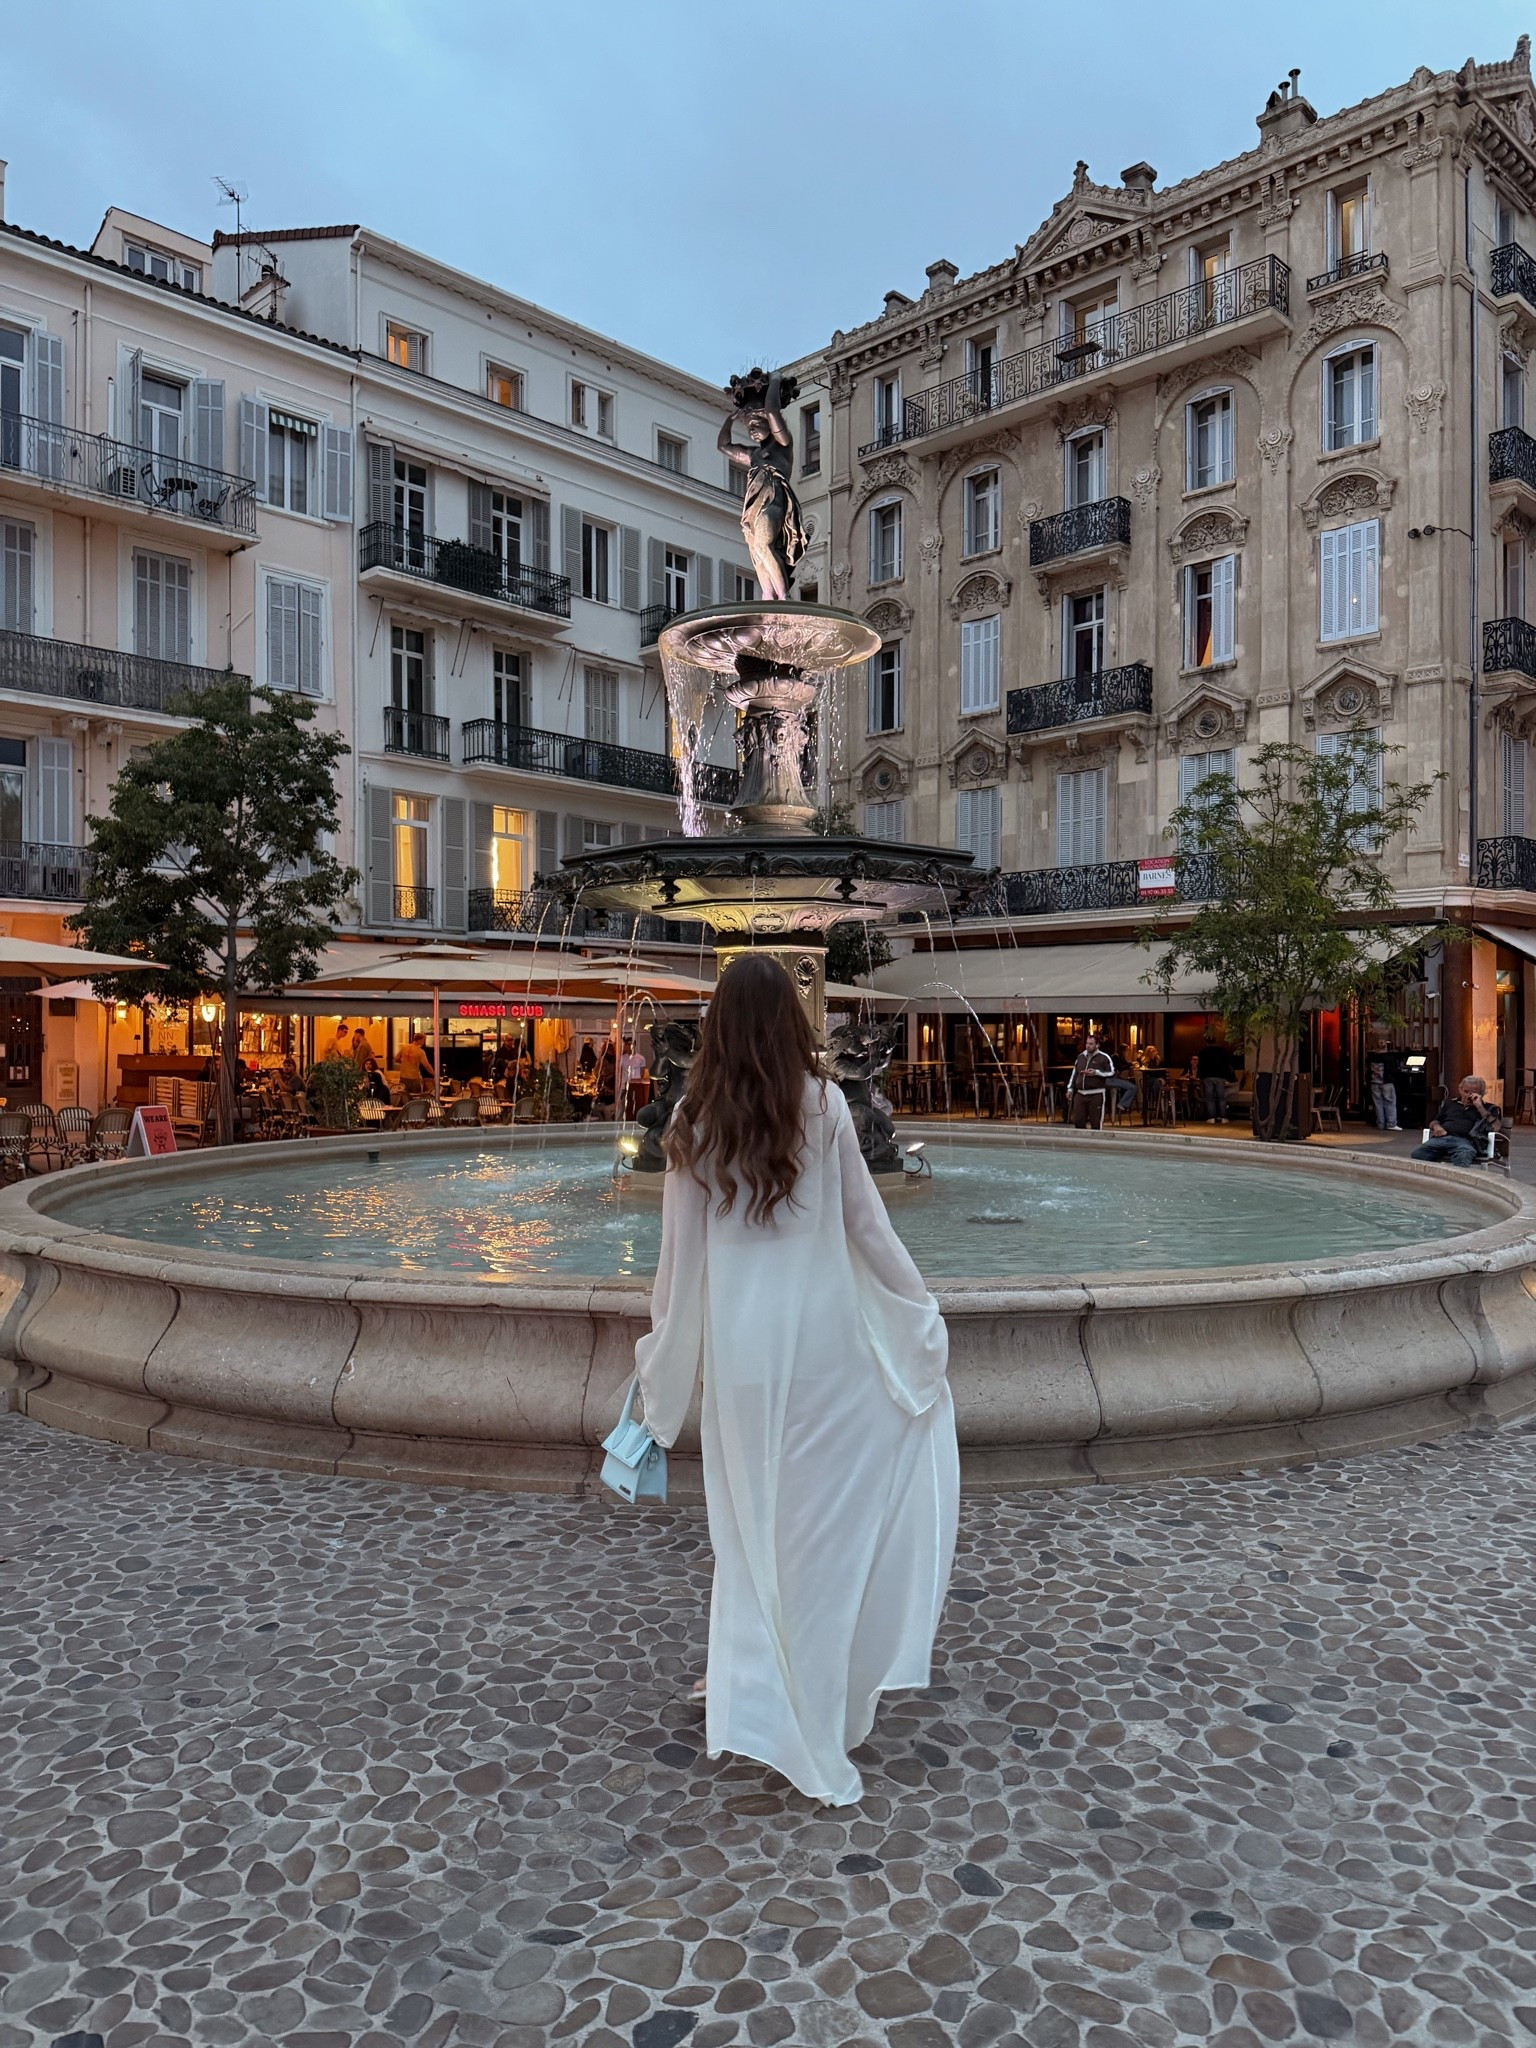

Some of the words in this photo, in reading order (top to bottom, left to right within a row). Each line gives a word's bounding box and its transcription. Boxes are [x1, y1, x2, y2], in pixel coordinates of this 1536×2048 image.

[1143, 871, 1172, 880] BARNES
[459, 1004, 506, 1016] SMASH
[511, 1005, 543, 1017] CLUB
[143, 1115, 154, 1123] WE
